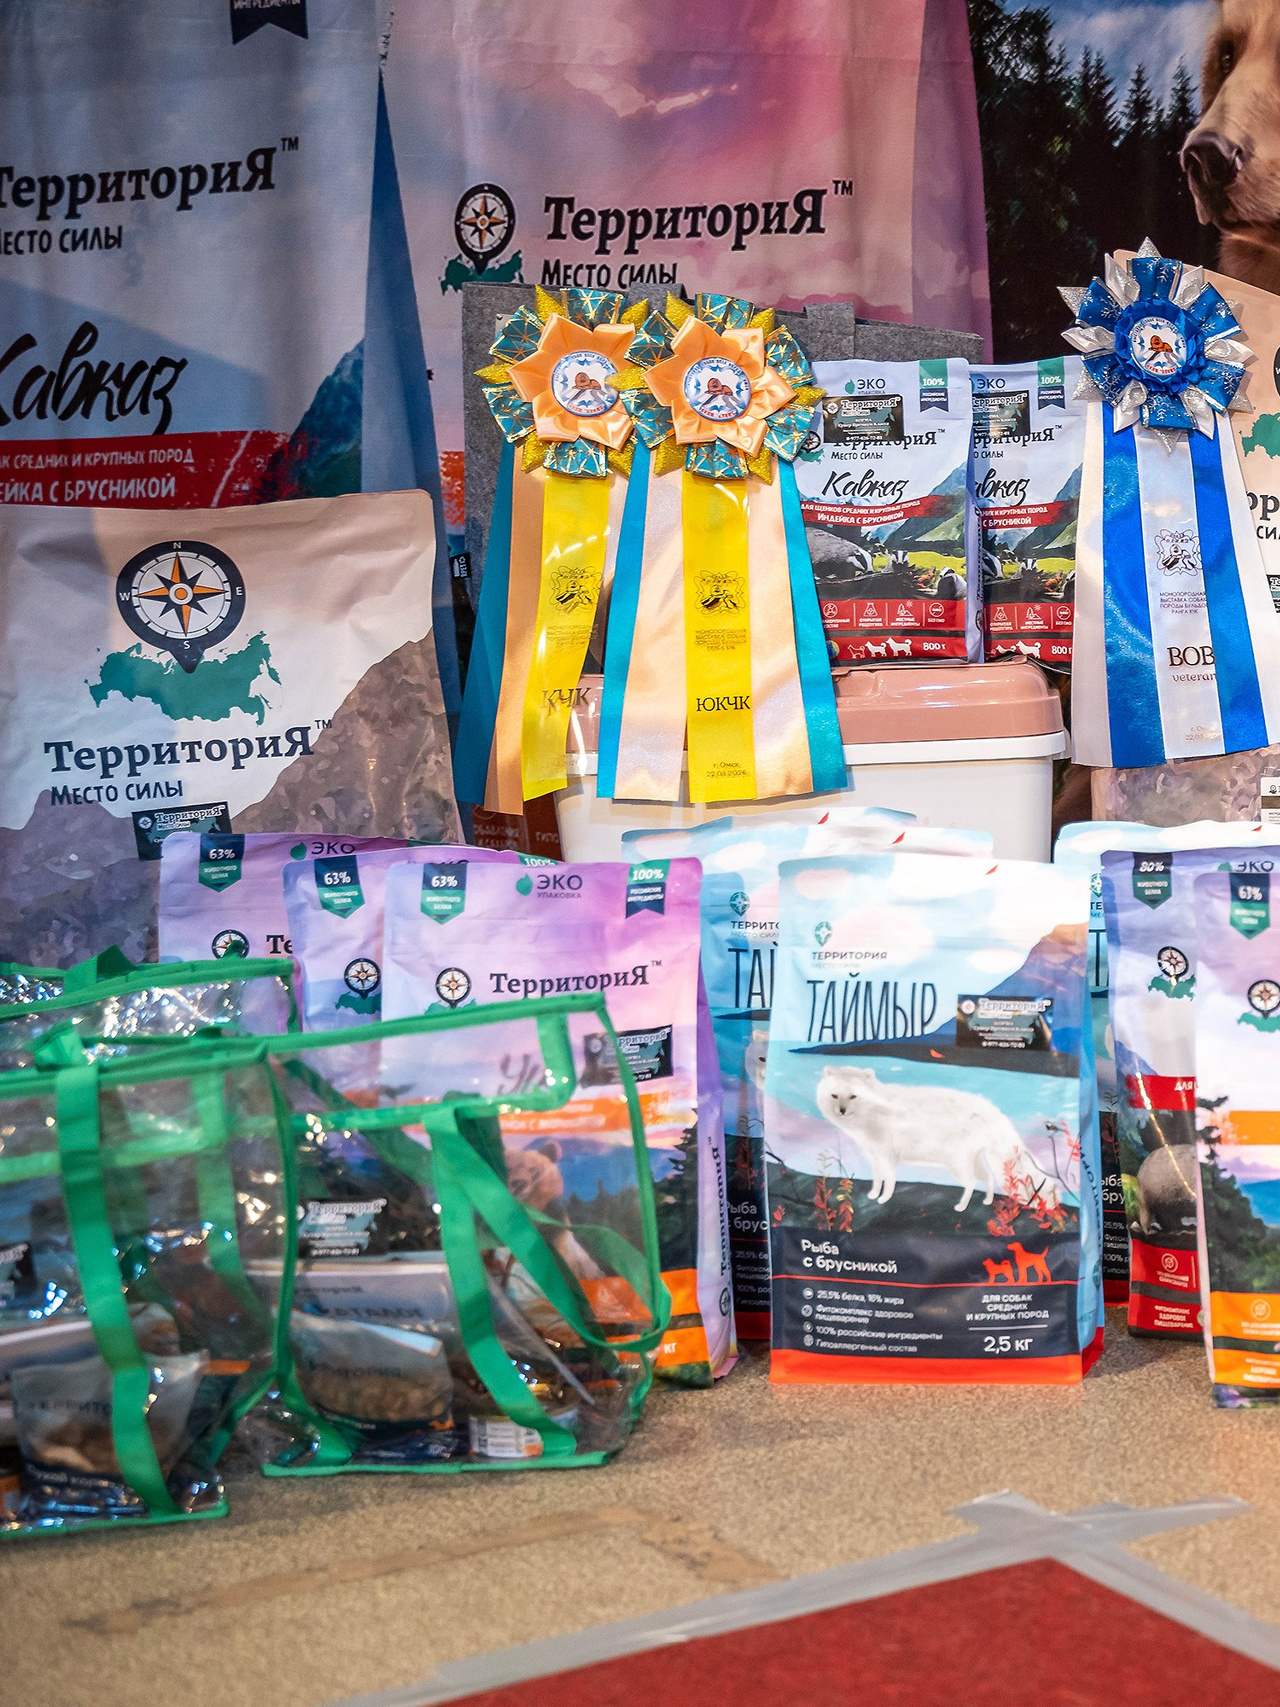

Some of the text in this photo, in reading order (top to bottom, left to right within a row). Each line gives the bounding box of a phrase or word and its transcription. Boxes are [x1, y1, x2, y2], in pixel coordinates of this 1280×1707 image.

[544, 188, 827, 256] ТерриториЯ
[857, 378, 886, 390] ЭКО
[922, 377, 945, 387] 100%
[977, 378, 1006, 390] ЭКО
[1040, 376, 1062, 385] 100%
[13, 448, 194, 469] СРЕДНИХ И КРУПНЫХ ПОРОД
[50, 474, 175, 502] С БРУСНИКОЙ
[821, 468, 909, 504] Кавказ
[901, 500, 921, 511] ПОРОД
[1028, 506, 1048, 514] ПОРОД
[817, 510, 904, 525] ИНДЕЙКА С БРУСНИКОЙ
[990, 516, 1032, 527] БРУСНИКОЙ
[173, 542, 181, 550] N
[119, 592, 130, 602] W
[236, 587, 243, 596] E
[183, 641, 191, 650] S
[922, 641, 939, 651] 800
[1051, 645, 1067, 655] 800
[696, 695, 751, 712] ЮКЧК
[43, 725, 314, 779] ТерриториЯ
[209, 848, 236, 860] 63%
[311, 841, 355, 855] ЭКО
[1139, 860, 1165, 873] 80%
[324, 871, 351, 885] 63%
[632, 868, 664, 881] 100%
[431, 875, 458, 887] 63%
[537, 874, 583, 891] ЭКО
[1238, 887, 1263, 901] 63%
[811, 951, 888, 961] ТЕРРИТОРИЯ
[489, 964, 649, 1000] ТерриториЯ
[806, 972, 937, 1043] ТАЙМЫР
[800, 1238, 840, 1256] Рыба
[802, 1255, 898, 1275] с брусникой
[981, 1294, 1033, 1304] ДЛЯ СОБАК
[986, 1303, 1028, 1312] СРЕДНИХ
[966, 1310, 1050, 1321] И КРУПНЫХ ПОРОД
[983, 1335, 1012, 1355] 2,5
